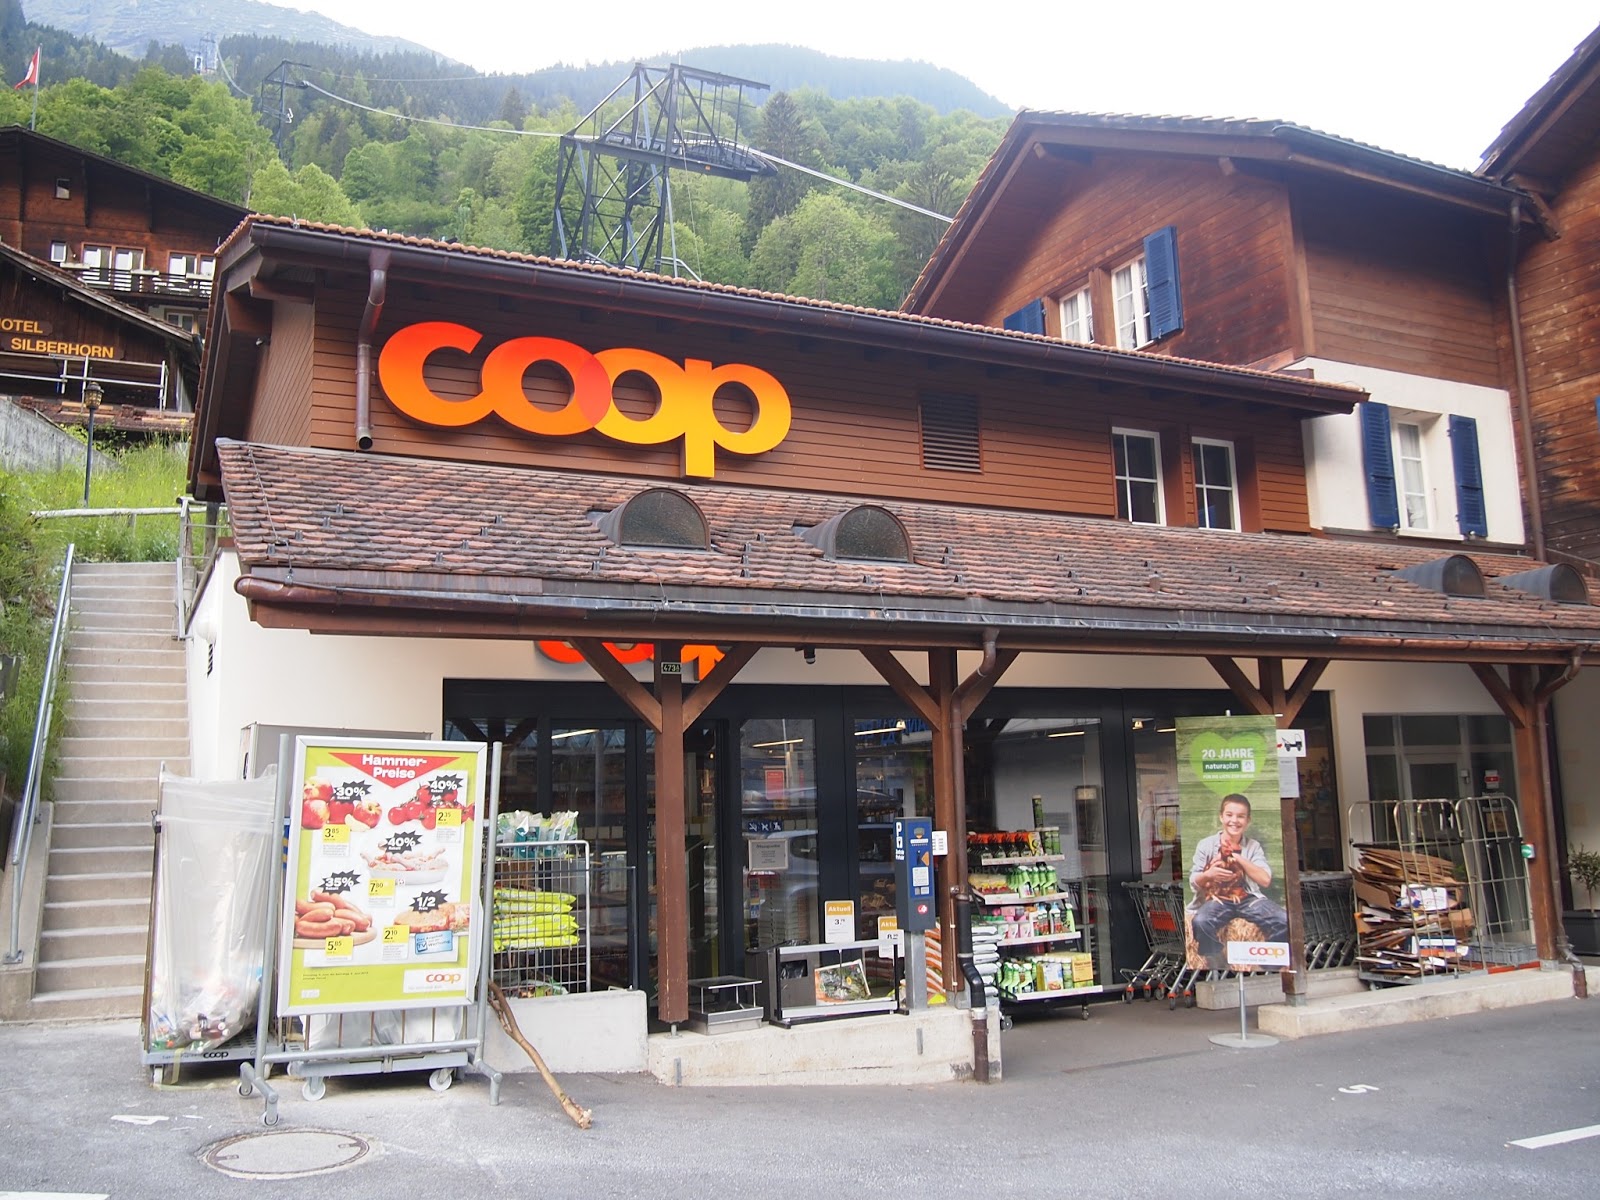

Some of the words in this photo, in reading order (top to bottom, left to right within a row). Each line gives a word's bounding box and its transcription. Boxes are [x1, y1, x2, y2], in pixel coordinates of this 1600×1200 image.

[11, 338, 114, 358] SILBERHORN
[378, 321, 792, 478] coop
[1201, 749, 1216, 759] 20
[1218, 748, 1254, 759] JAHRE
[362, 754, 428, 767] Hammer-
[373, 767, 416, 779] Preise
[429, 780, 458, 790] 40%
[336, 787, 366, 797] 30%
[895, 822, 902, 837] P
[388, 837, 416, 847] 40%
[325, 877, 354, 887] 35%
[416, 896, 436, 907] 1/2
[1249, 946, 1285, 959] coop
[426, 973, 461, 984] coop
[203, 1051, 229, 1059] coop
